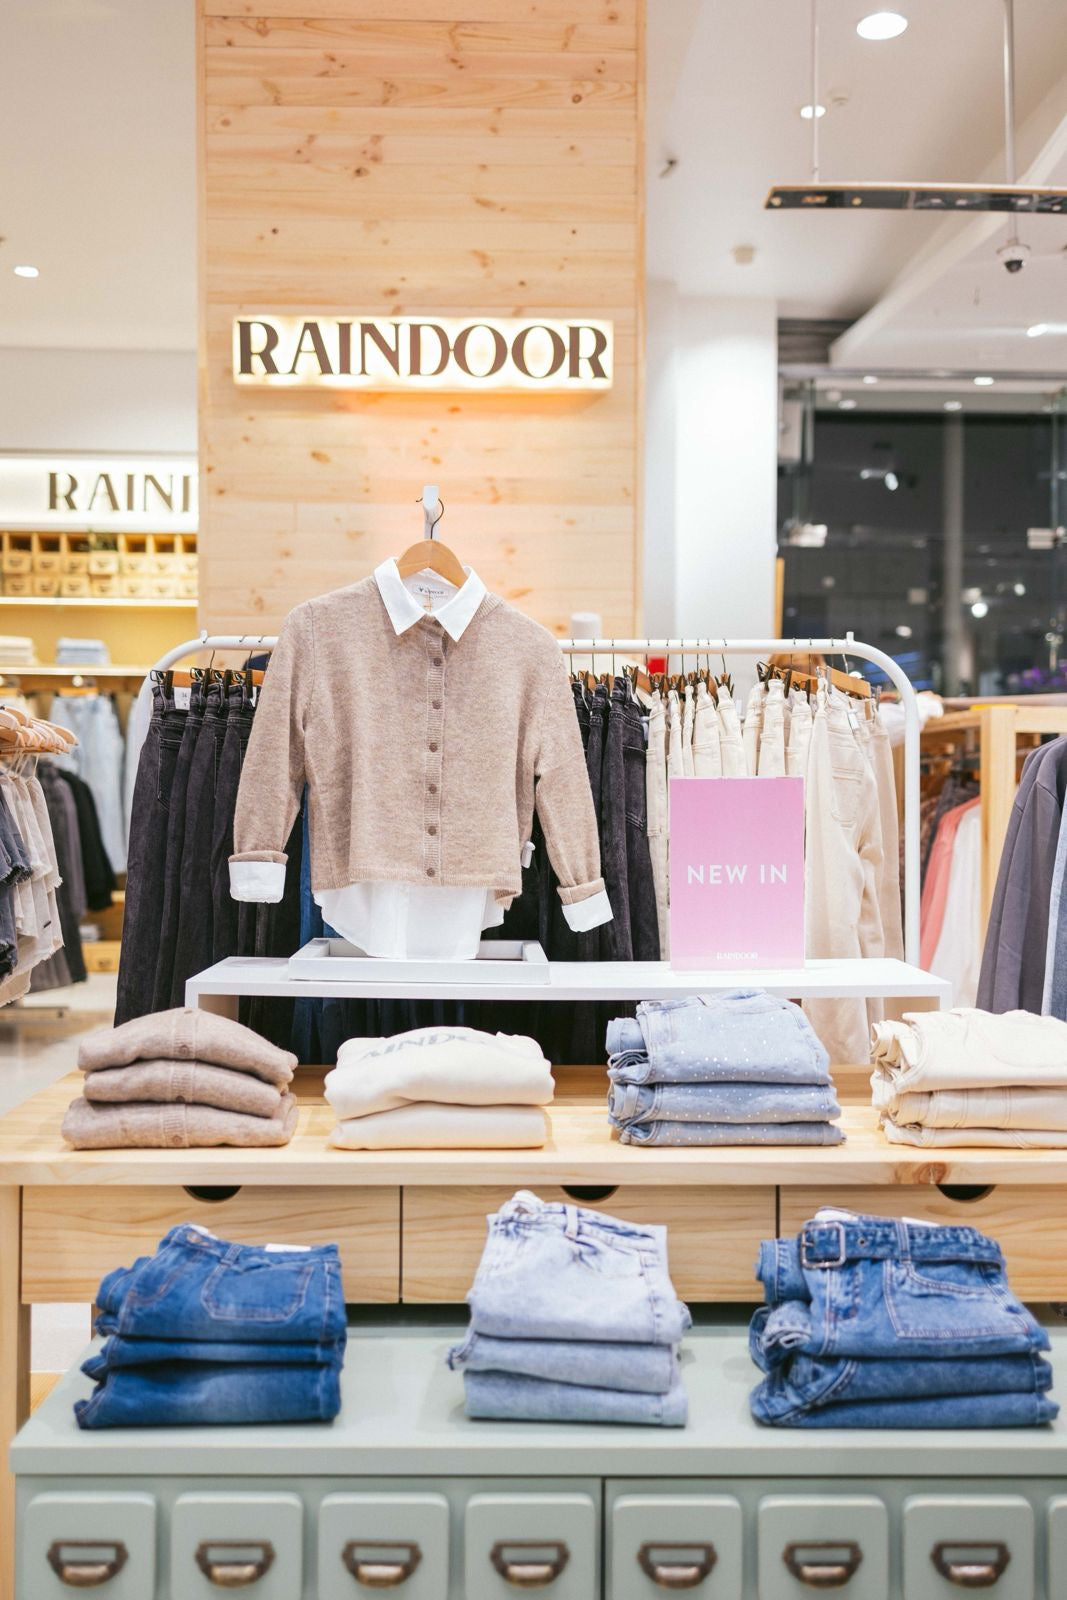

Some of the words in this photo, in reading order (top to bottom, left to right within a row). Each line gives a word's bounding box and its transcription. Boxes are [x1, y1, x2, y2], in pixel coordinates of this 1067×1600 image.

[237, 320, 610, 380] RAINDOOR
[686, 864, 748, 884] NEW
[759, 864, 789, 884] IN
